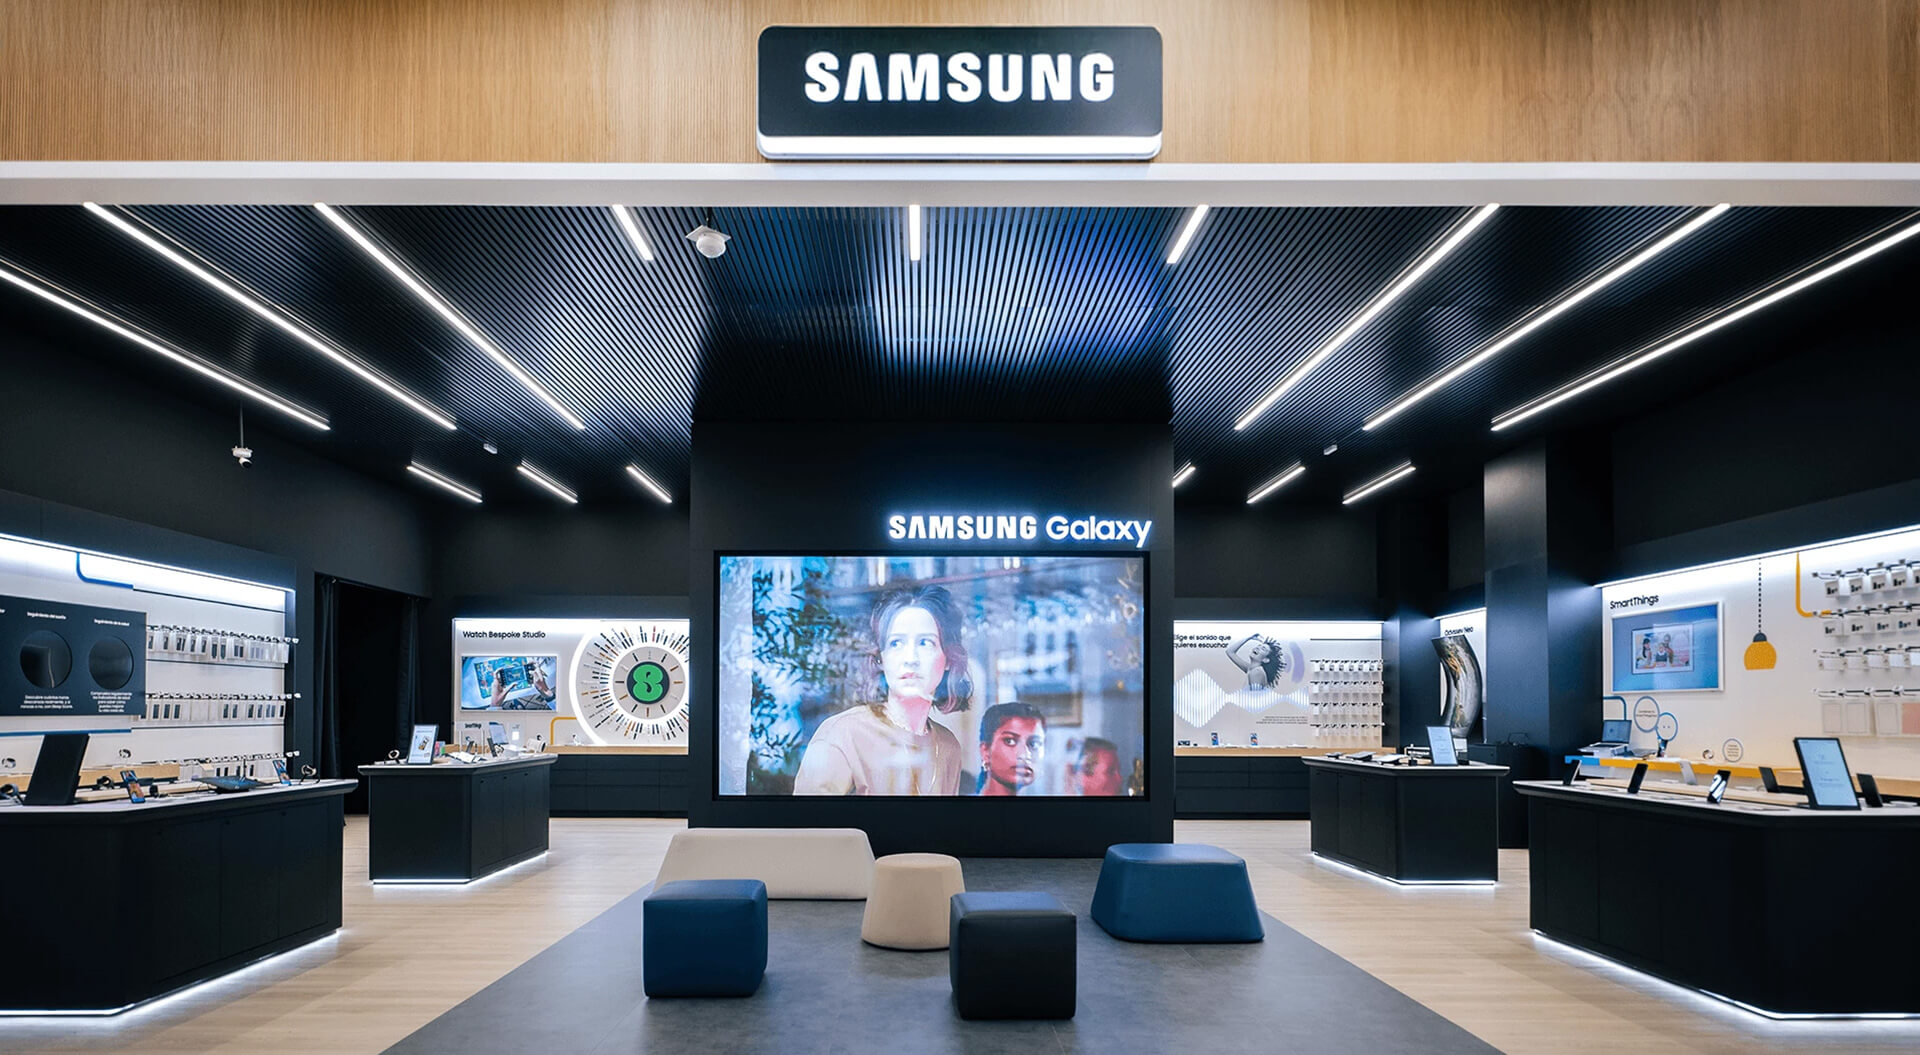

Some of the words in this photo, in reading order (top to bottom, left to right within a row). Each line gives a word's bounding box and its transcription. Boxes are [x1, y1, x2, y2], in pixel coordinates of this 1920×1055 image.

[804, 51, 1115, 103] SAMSUNG
[888, 515, 1037, 540] SAMSUNG
[1045, 515, 1152, 548] Galaxy
[1610, 594, 1659, 610] SmartThings
[488, 631, 520, 640] Bespoke
